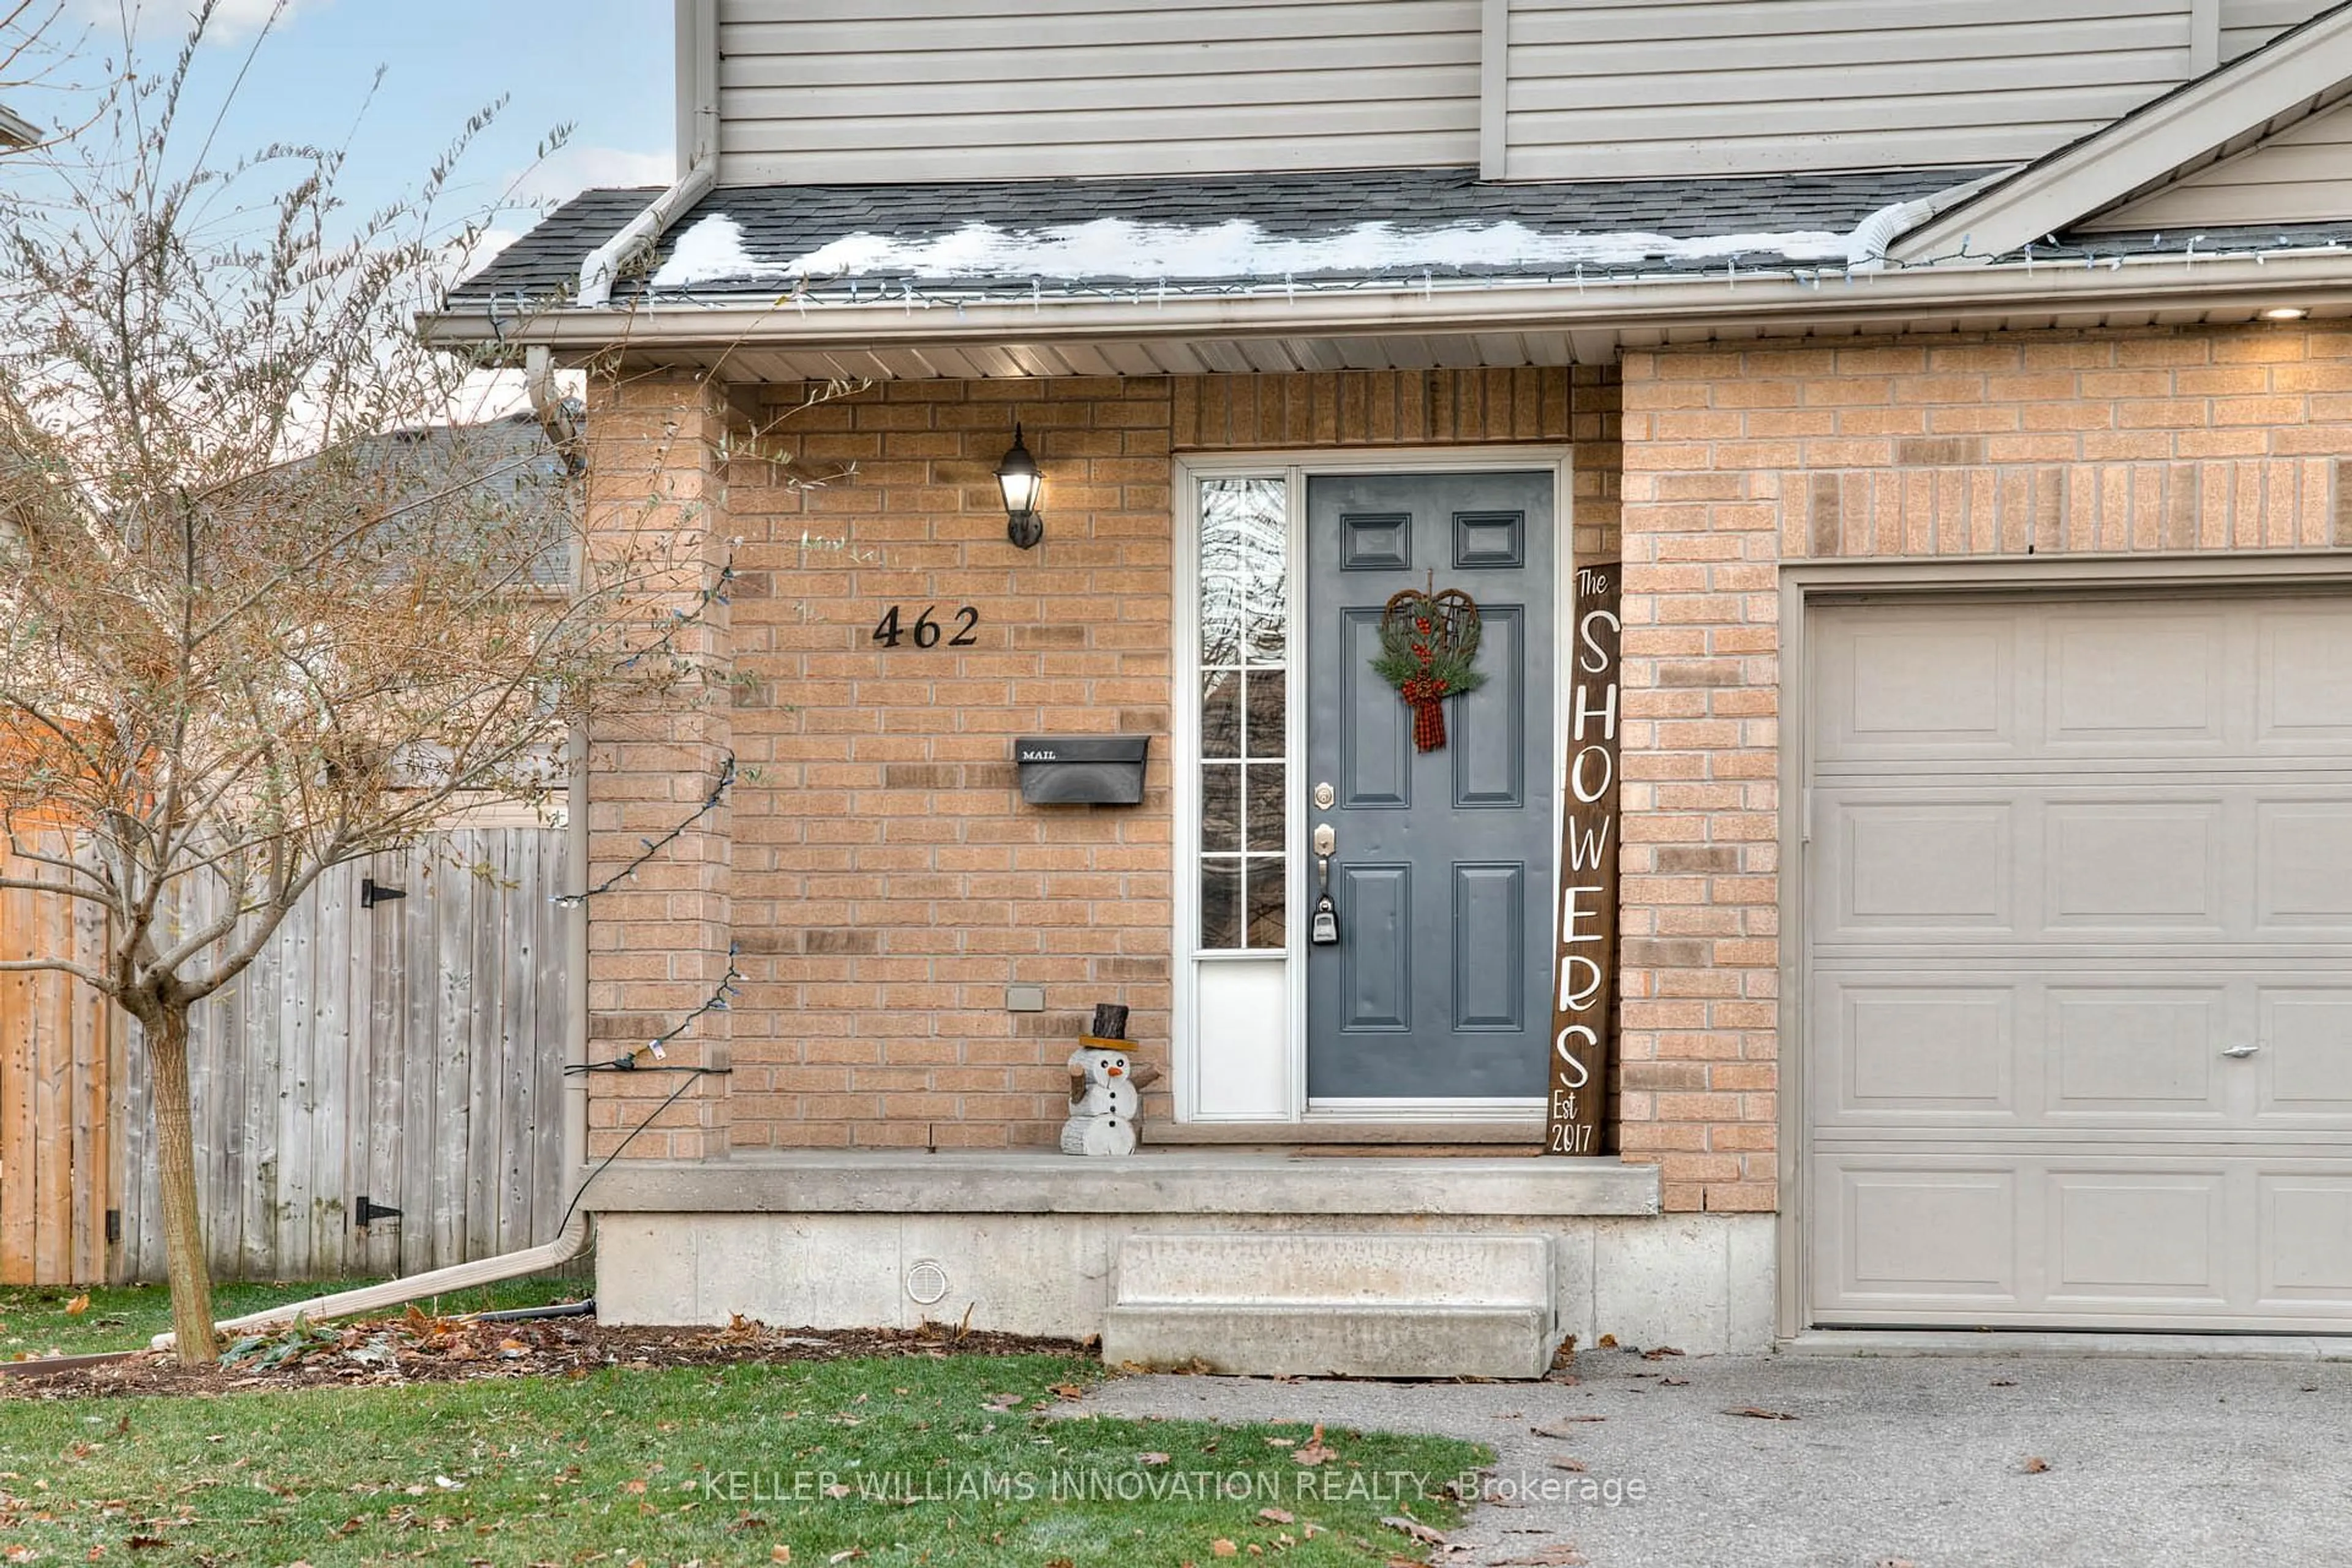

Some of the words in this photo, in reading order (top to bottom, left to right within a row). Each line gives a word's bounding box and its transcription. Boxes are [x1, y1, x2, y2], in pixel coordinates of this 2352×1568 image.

[1575, 569, 1608, 597] The
[872, 605, 979, 648] 462
[1023, 751, 1055, 760] MAIL
[1556, 610, 1621, 1088] SHOWERS
[1553, 1090, 1578, 1120] Est
[1552, 1125, 1592, 1153] 2017
